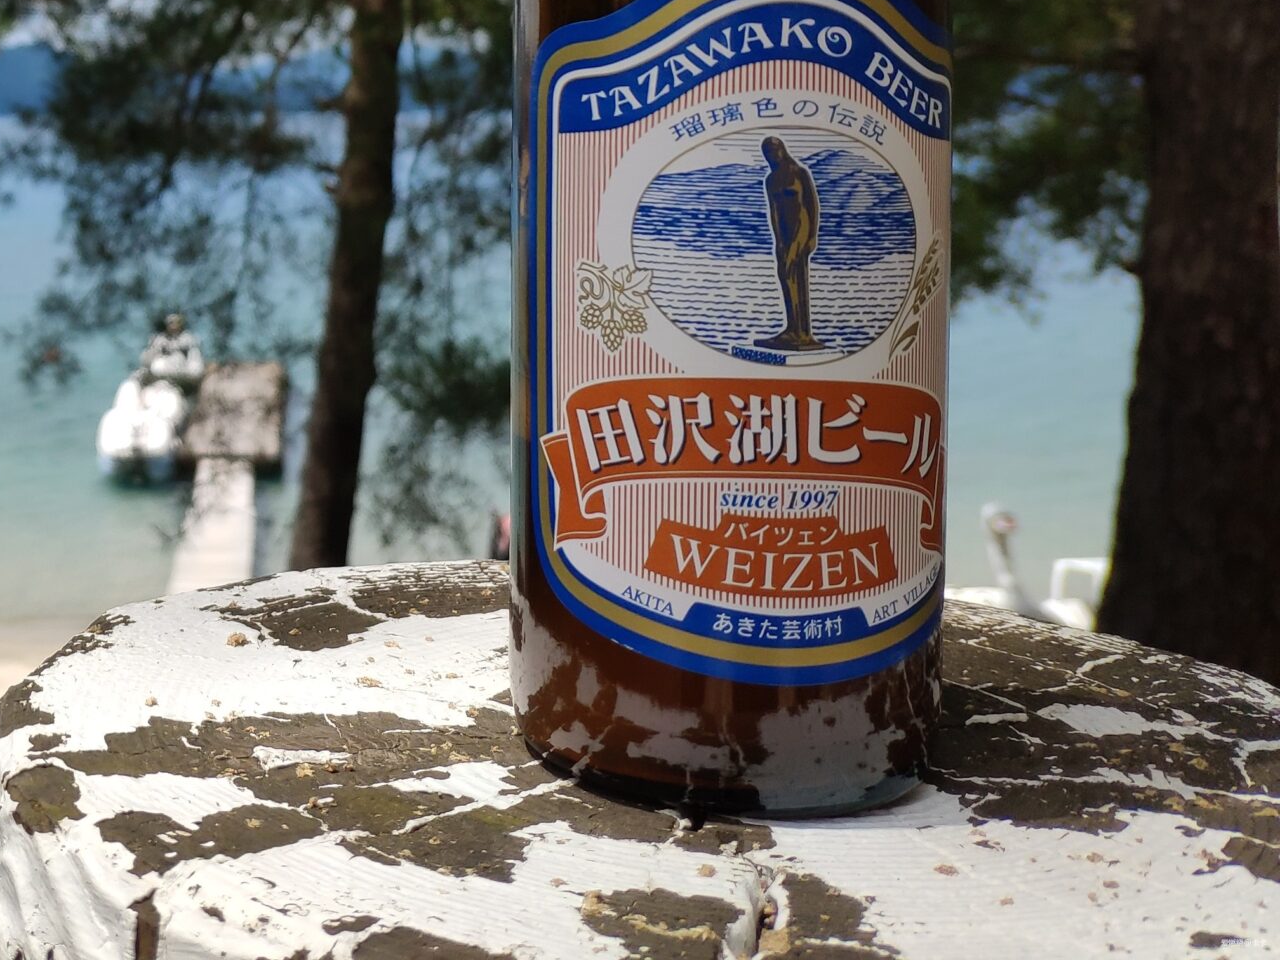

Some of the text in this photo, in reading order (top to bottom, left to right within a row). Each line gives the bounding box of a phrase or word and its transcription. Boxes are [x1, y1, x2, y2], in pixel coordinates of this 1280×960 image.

[581, 18, 944, 129] TAZAWAKO BEER
[669, 97, 888, 146] 瑠璃色の伝説
[575, 392, 937, 477] 田沢湖ビール
[720, 487, 839, 510] since 1997
[724, 522, 838, 546] バイツェン
[670, 533, 880, 591] WEIZEN
[622, 585, 674, 617] AKITA
[872, 600, 899, 624] ART
[712, 613, 843, 640] あきた芸術村
